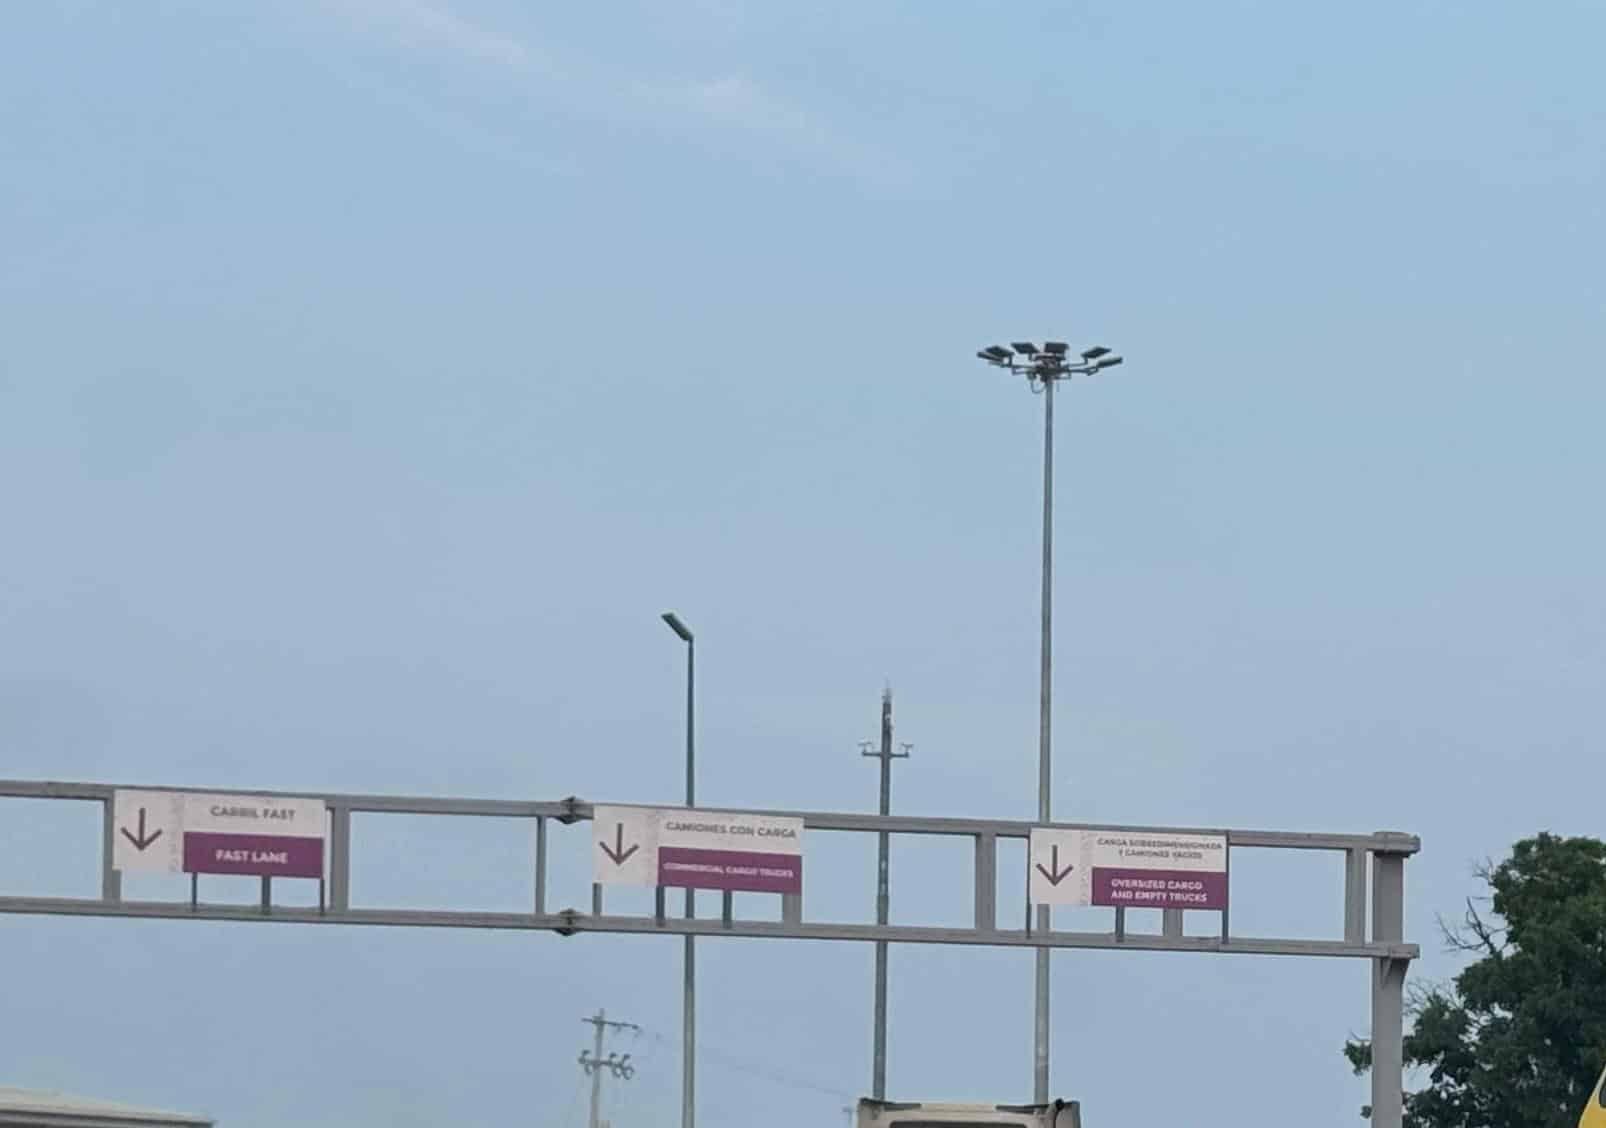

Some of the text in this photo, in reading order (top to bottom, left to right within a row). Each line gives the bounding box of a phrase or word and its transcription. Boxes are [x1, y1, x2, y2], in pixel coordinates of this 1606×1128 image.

[210, 805, 296, 820] CARRIL FAST
[666, 821, 796, 838] CAMIONES CON CARGA
[1097, 837, 1127, 846] CARGA
[215, 849, 288, 864] FAST LANE
[1167, 880, 1203, 890] CARGO
[1111, 890, 1208, 902] AND EMPTY TRUCKS
